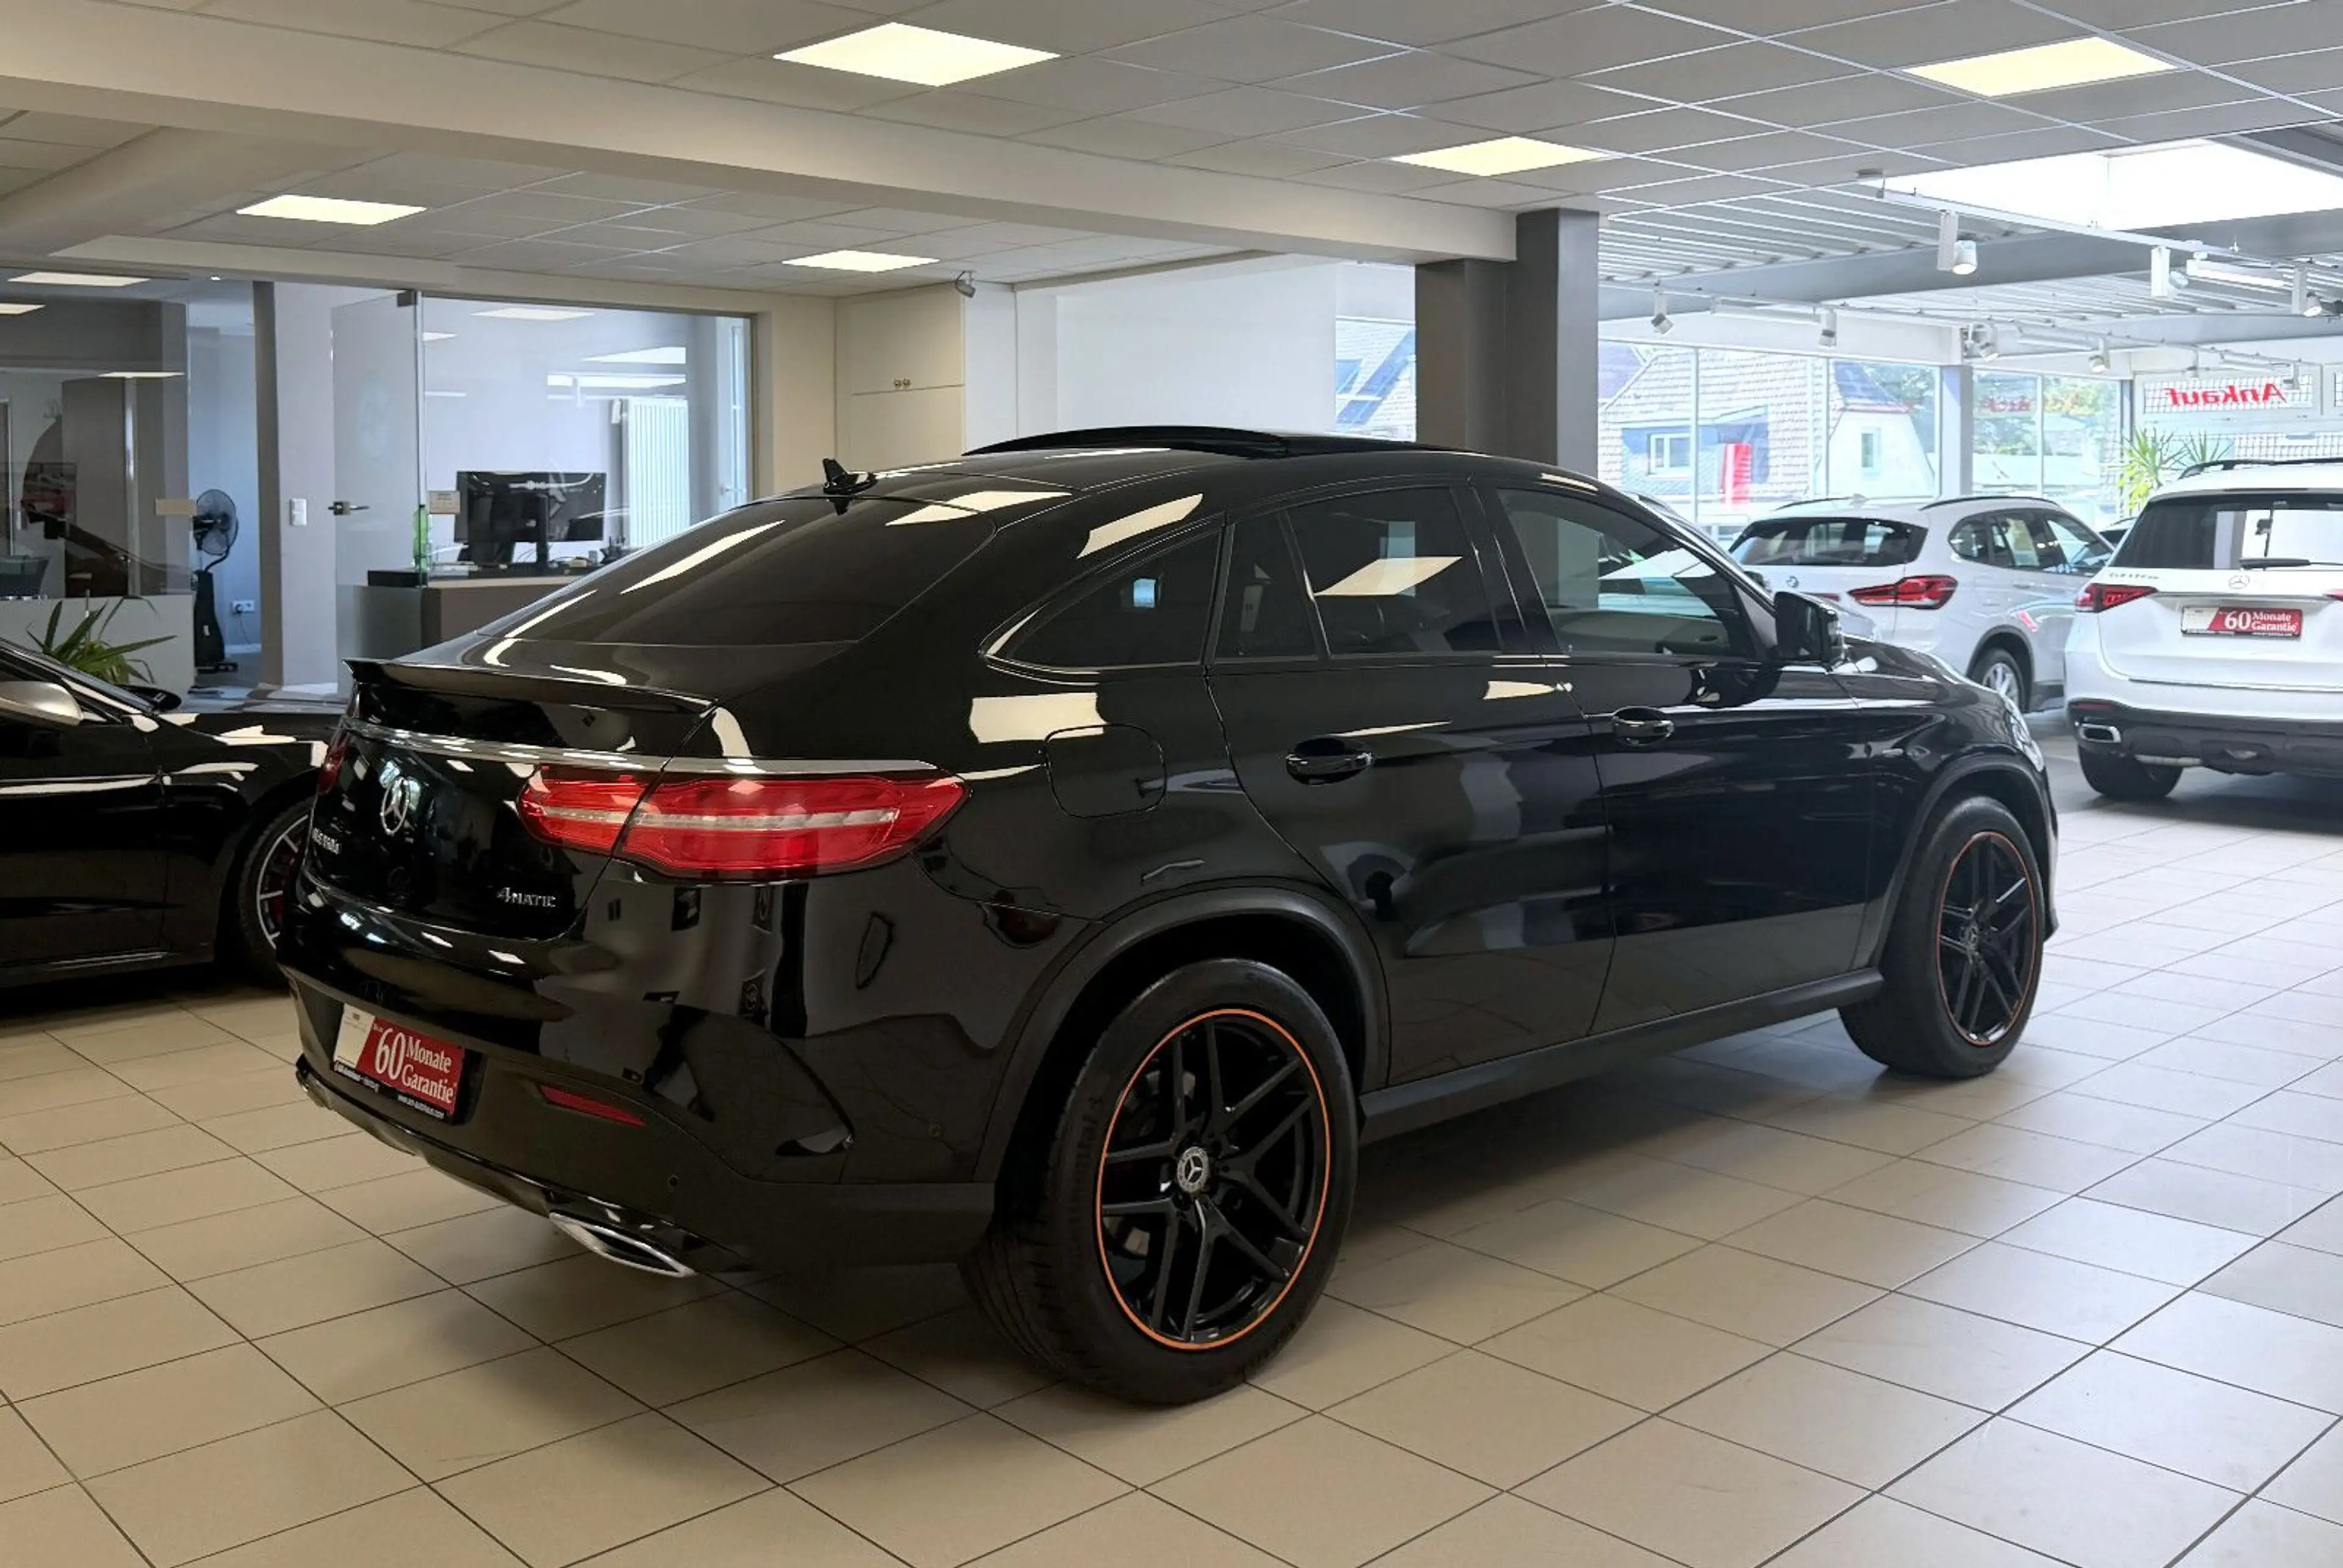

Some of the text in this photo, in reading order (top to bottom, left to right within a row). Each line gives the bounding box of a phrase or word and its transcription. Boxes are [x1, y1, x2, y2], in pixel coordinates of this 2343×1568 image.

[2224, 611, 2292, 630] 60 Monate
[375, 1027, 406, 1081] 60
[405, 1036, 452, 1074] Monate
[401, 1063, 454, 1104] Garantie
